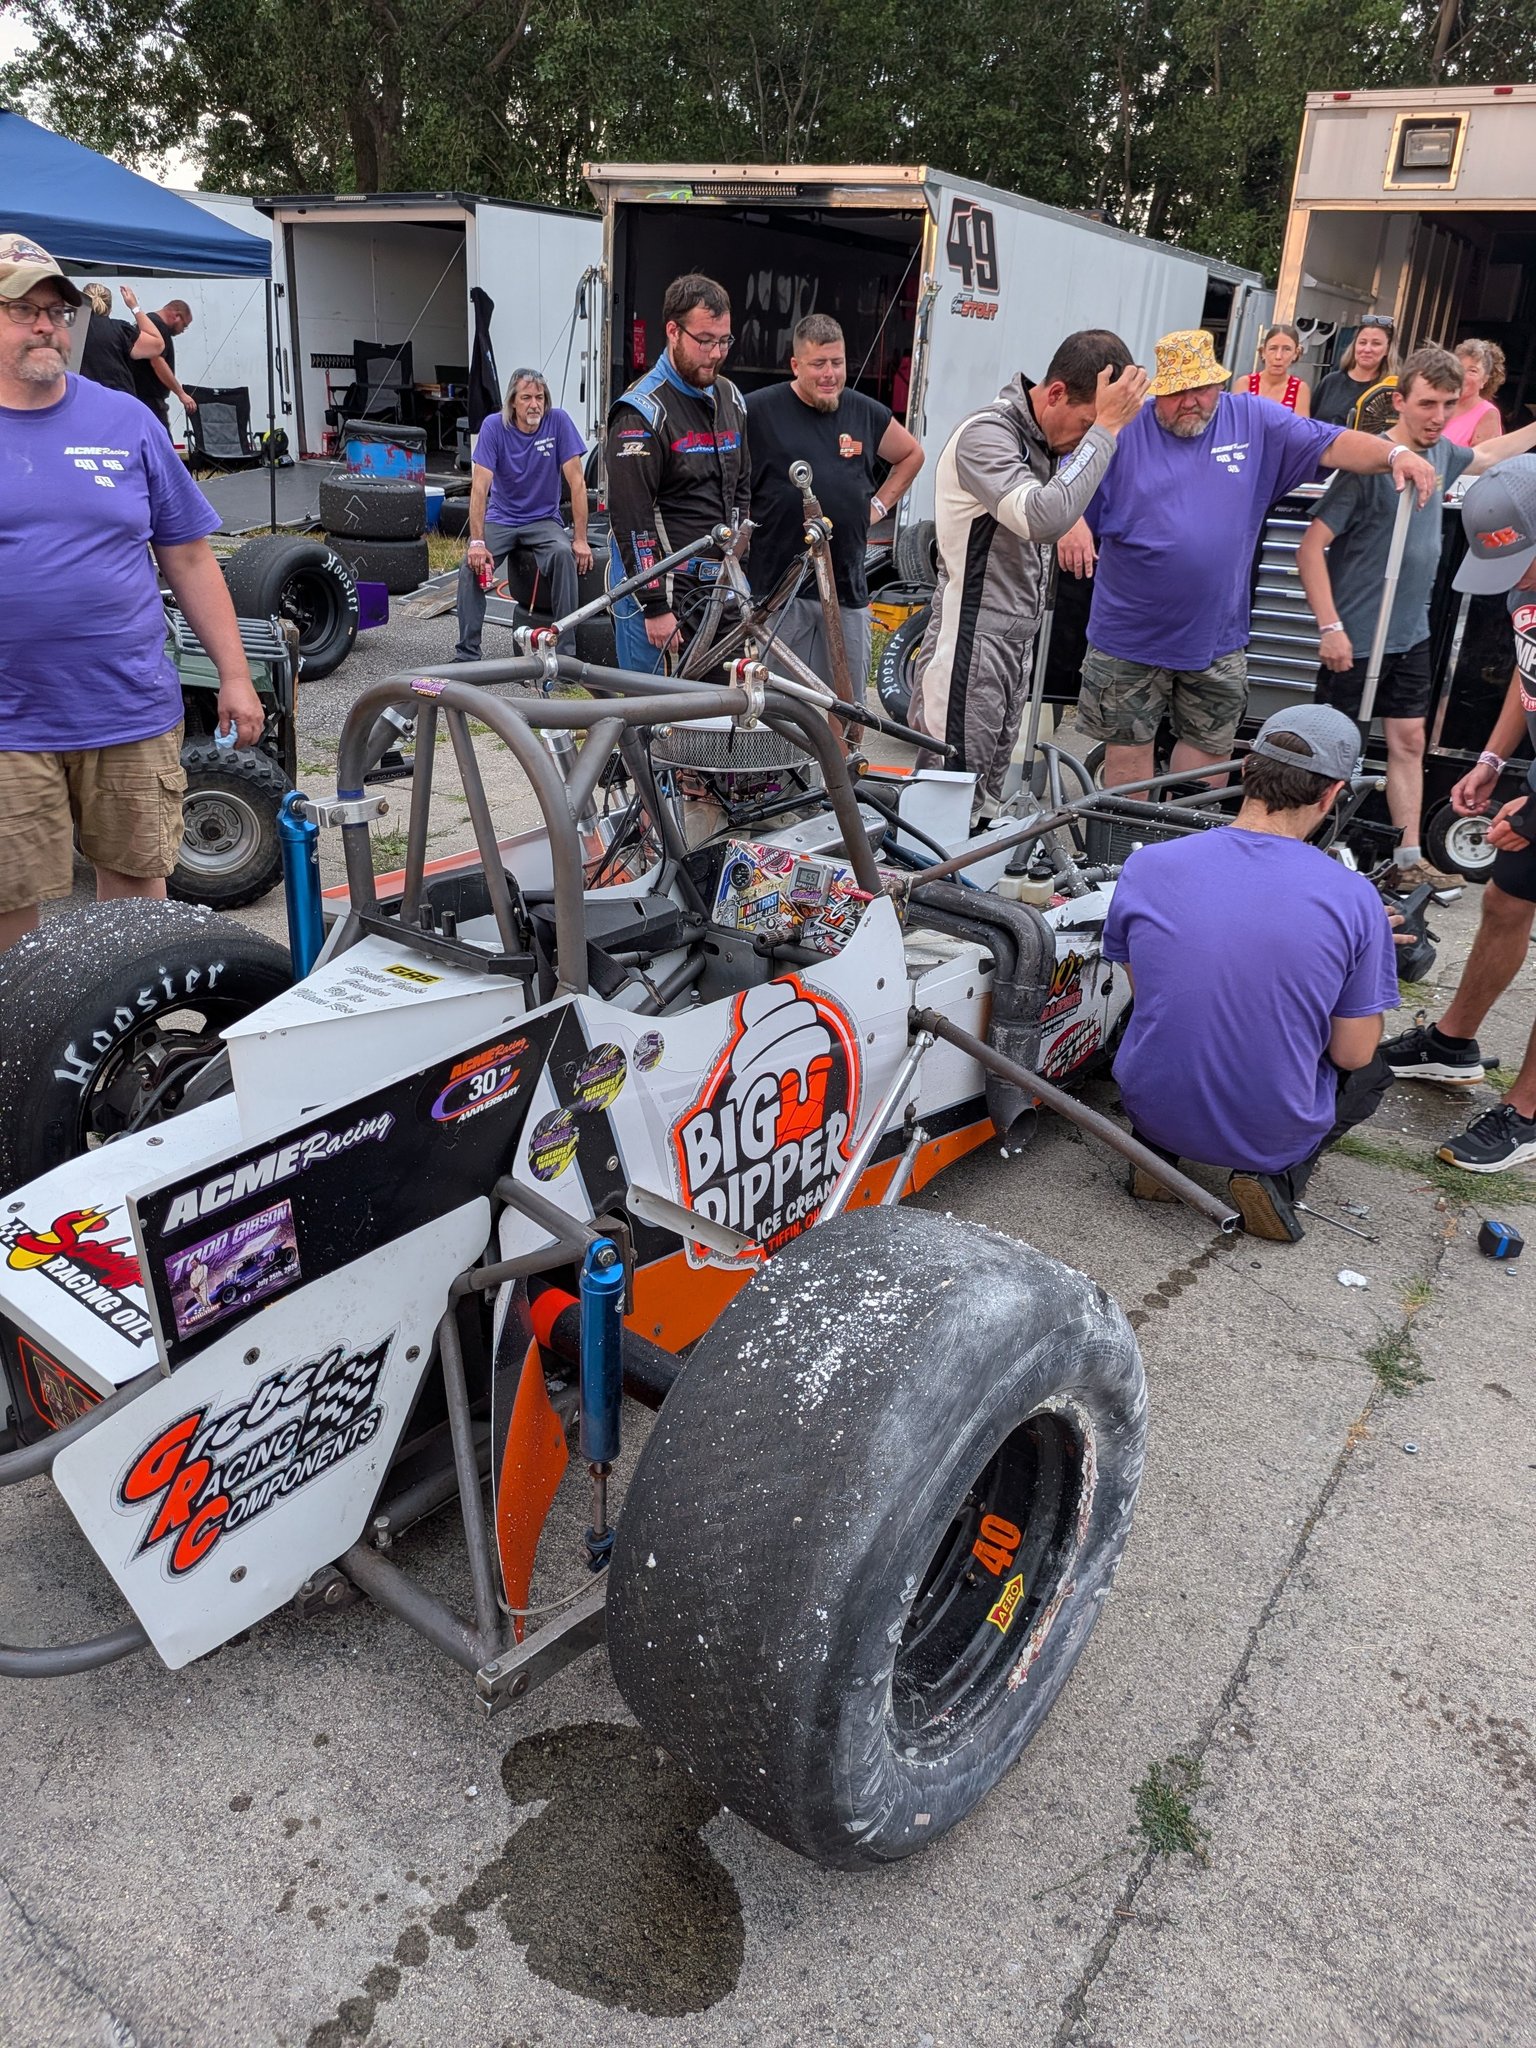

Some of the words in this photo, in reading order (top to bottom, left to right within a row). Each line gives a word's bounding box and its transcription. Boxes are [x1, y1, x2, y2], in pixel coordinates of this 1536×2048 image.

[947, 196, 999, 292] 49
[961, 301, 998, 320] STOUT
[64, 447, 102, 455] ACME
[102, 447, 130, 457] Racing
[74, 459, 99, 470] 40
[102, 459, 125, 470] 46
[1060, 442, 1096, 485] SIMPSON
[94, 475, 116, 488] 49
[322, 552, 359, 613] Hoosier
[1513, 607, 1536, 629] G
[881, 633, 904, 699] Hoosier
[759, 850, 780, 868] RHINO
[761, 894, 778, 910] FIRST
[764, 905, 778, 917] LAST
[387, 966, 438, 983] GAS
[54, 962, 225, 1084] Hoosier
[1043, 1009, 1098, 1068] SPEEDWAY
[450, 1046, 496, 1080] ACME
[495, 1038, 529, 1058] Racing
[1046, 1020, 1100, 1078] ACTION
[1060, 1033, 1101, 1077] IMAGES
[457, 1085, 520, 1123] ANNIVERSARY
[469, 1068, 497, 1101] 30
[500, 1065, 511, 1076] TH
[583, 1077, 617, 1097] FEATURE
[585, 1083, 617, 1102] WINNER
[682, 1075, 781, 1191] BIG
[163, 1142, 300, 1234] ACME
[301, 1113, 393, 1168] Racing
[536, 1146, 568, 1164] FEATURE
[538, 1152, 568, 1170] WINNER
[694, 1110, 847, 1231] DIPPER
[756, 1214, 783, 1241] ICE
[786, 1176, 836, 1223] CREAM
[172, 1232, 228, 1282] TODD
[232, 1205, 287, 1244] GIBSON
[42, 1256, 122, 1313] RACING
[111, 1308, 152, 1340] OIL
[256, 1276, 269, 1288] July
[125, 1352, 340, 1499] Greber
[148, 1422, 298, 1543] RACING
[174, 1412, 378, 1570] COMPONENTS
[972, 1514, 1021, 1576] 40
[999, 1585, 1019, 1622] AERO
